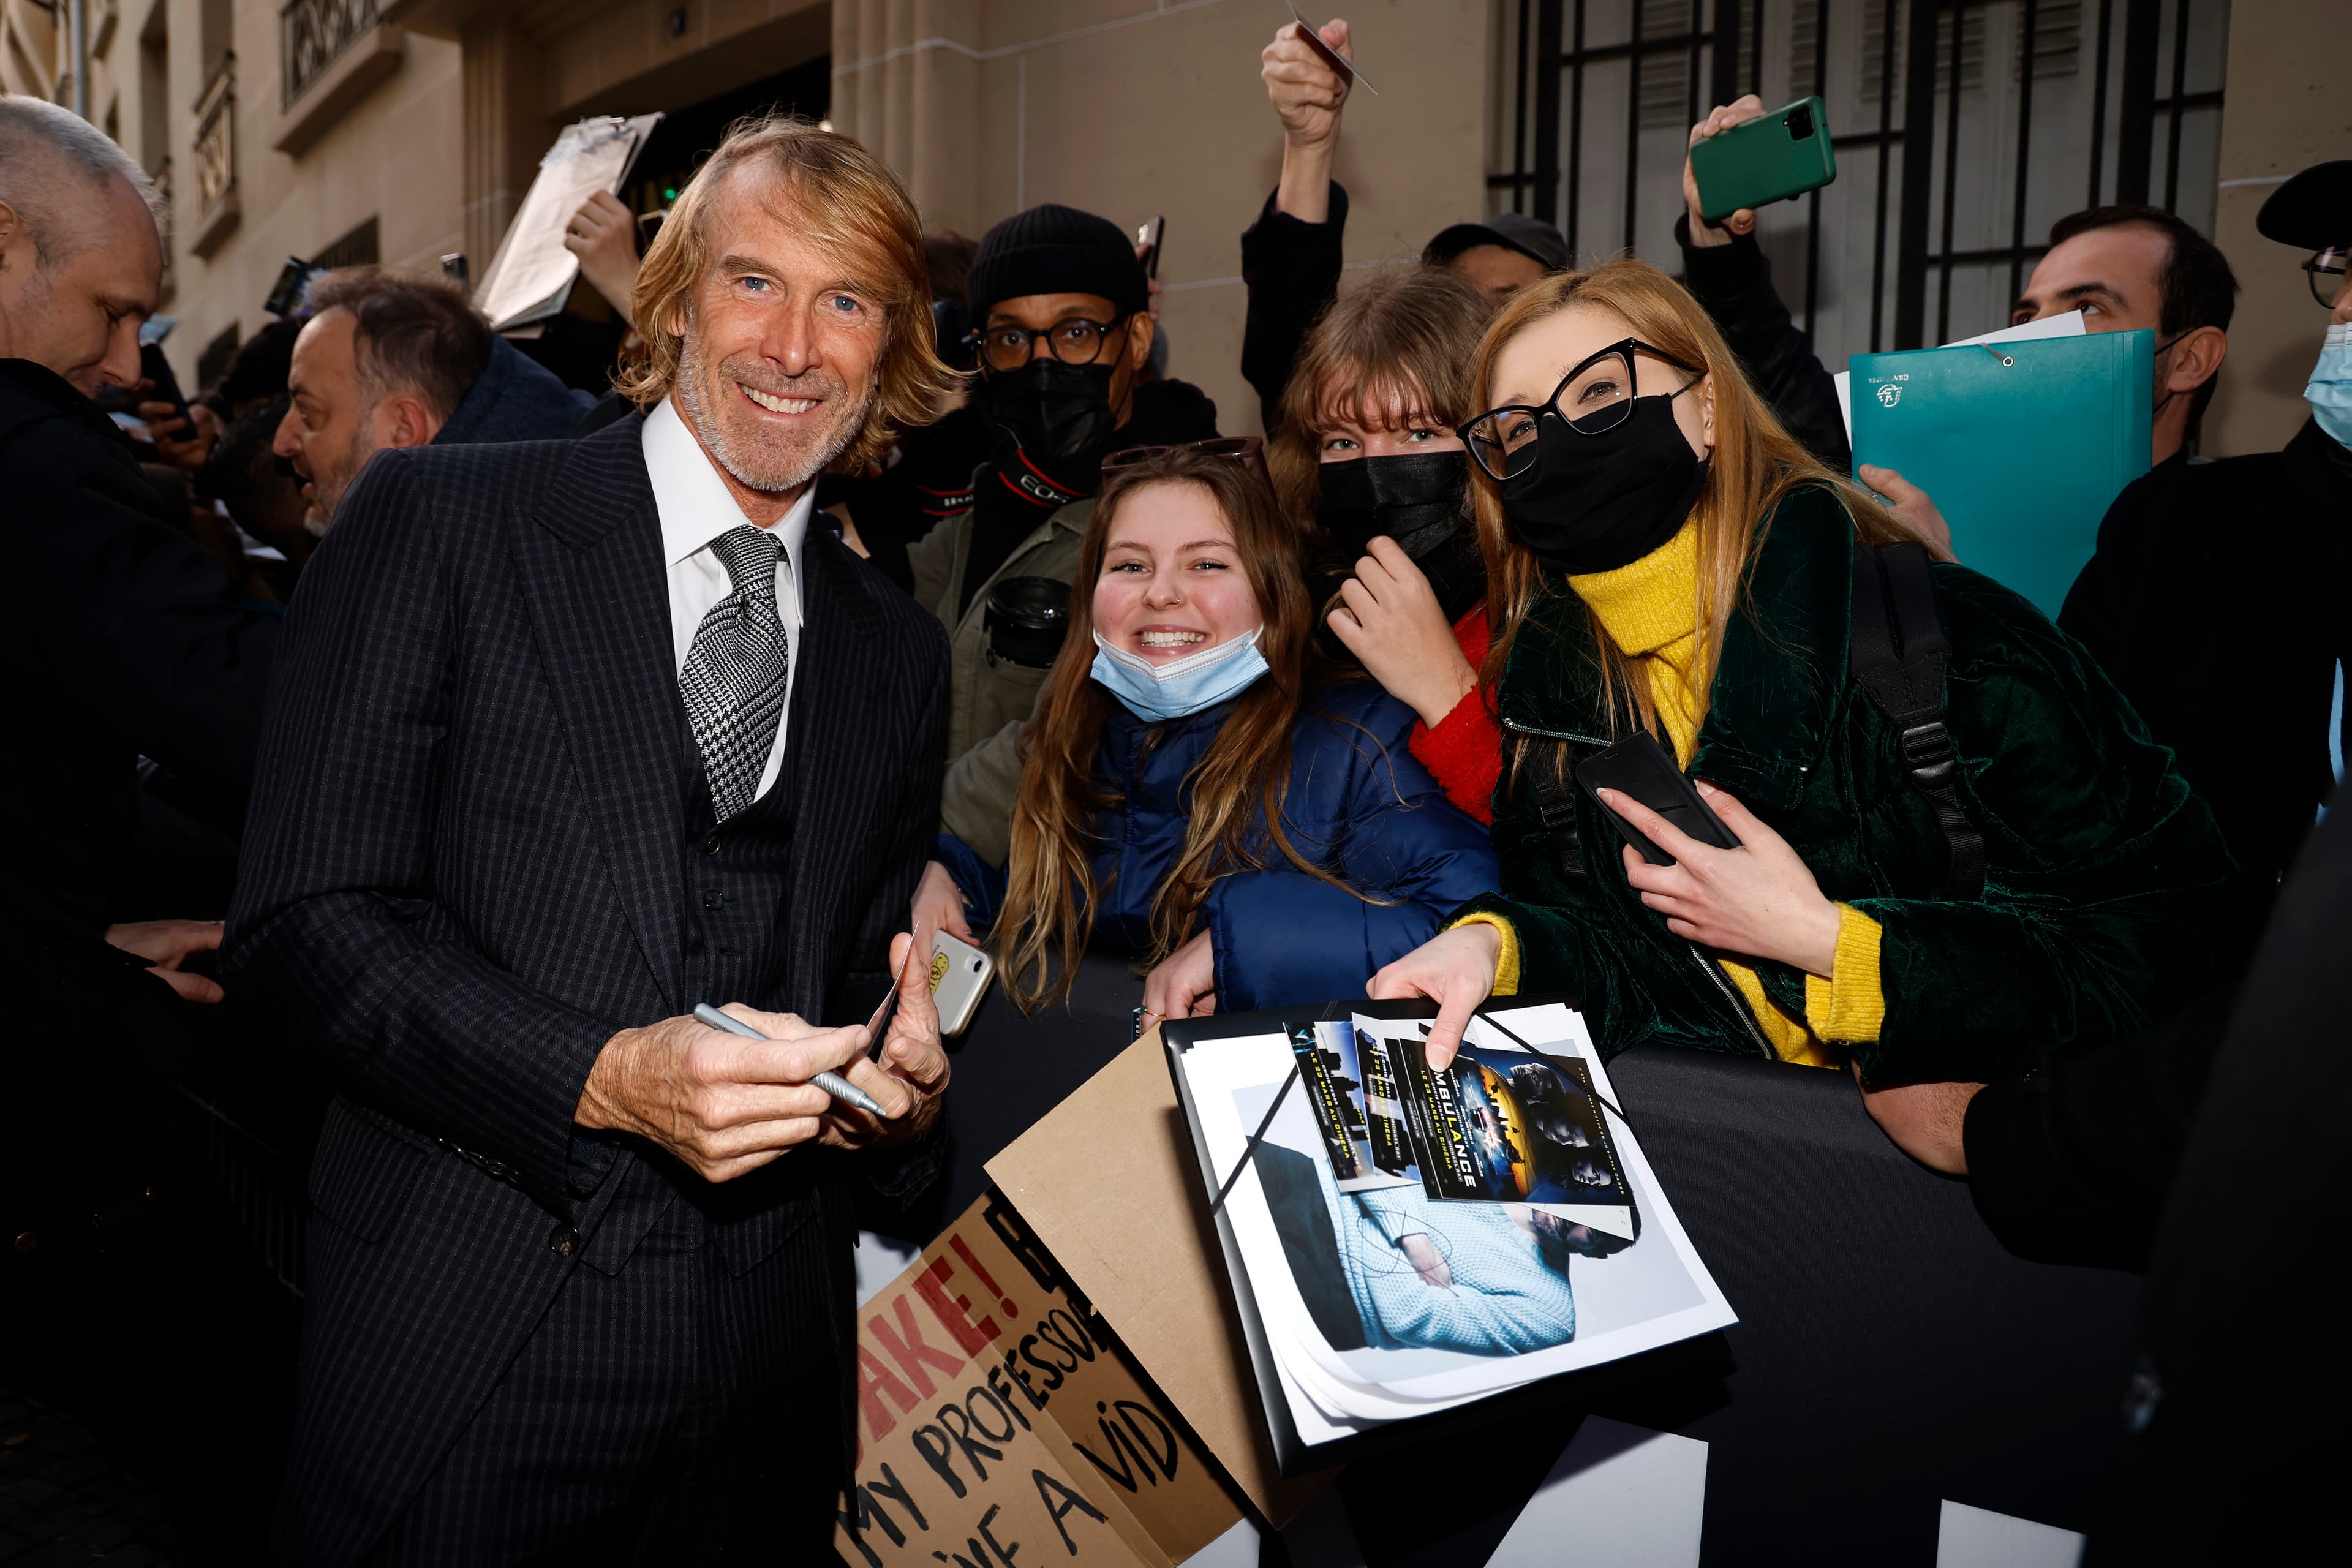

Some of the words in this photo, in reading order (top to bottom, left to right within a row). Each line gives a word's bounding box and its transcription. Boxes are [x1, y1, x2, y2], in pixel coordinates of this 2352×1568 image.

[1310, 1052, 1317, 1063] LE
[1321, 1082, 1332, 1106] MARS
[1330, 1109, 1337, 1121] AU
[1420, 1071, 1427, 1079] LE
[1424, 1084, 1430, 1093] 23
[1428, 1097, 1438, 1119] MARS
[1435, 1123, 1442, 1133] AU
[1433, 1071, 1476, 1187] MBULANCE
[1455, 1109, 1465, 1134] MICHAEL
[855, 1233, 1019, 1458] AKE!
[837, 1462, 930, 1568] MY
[1031, 1469, 1109, 1556] A
